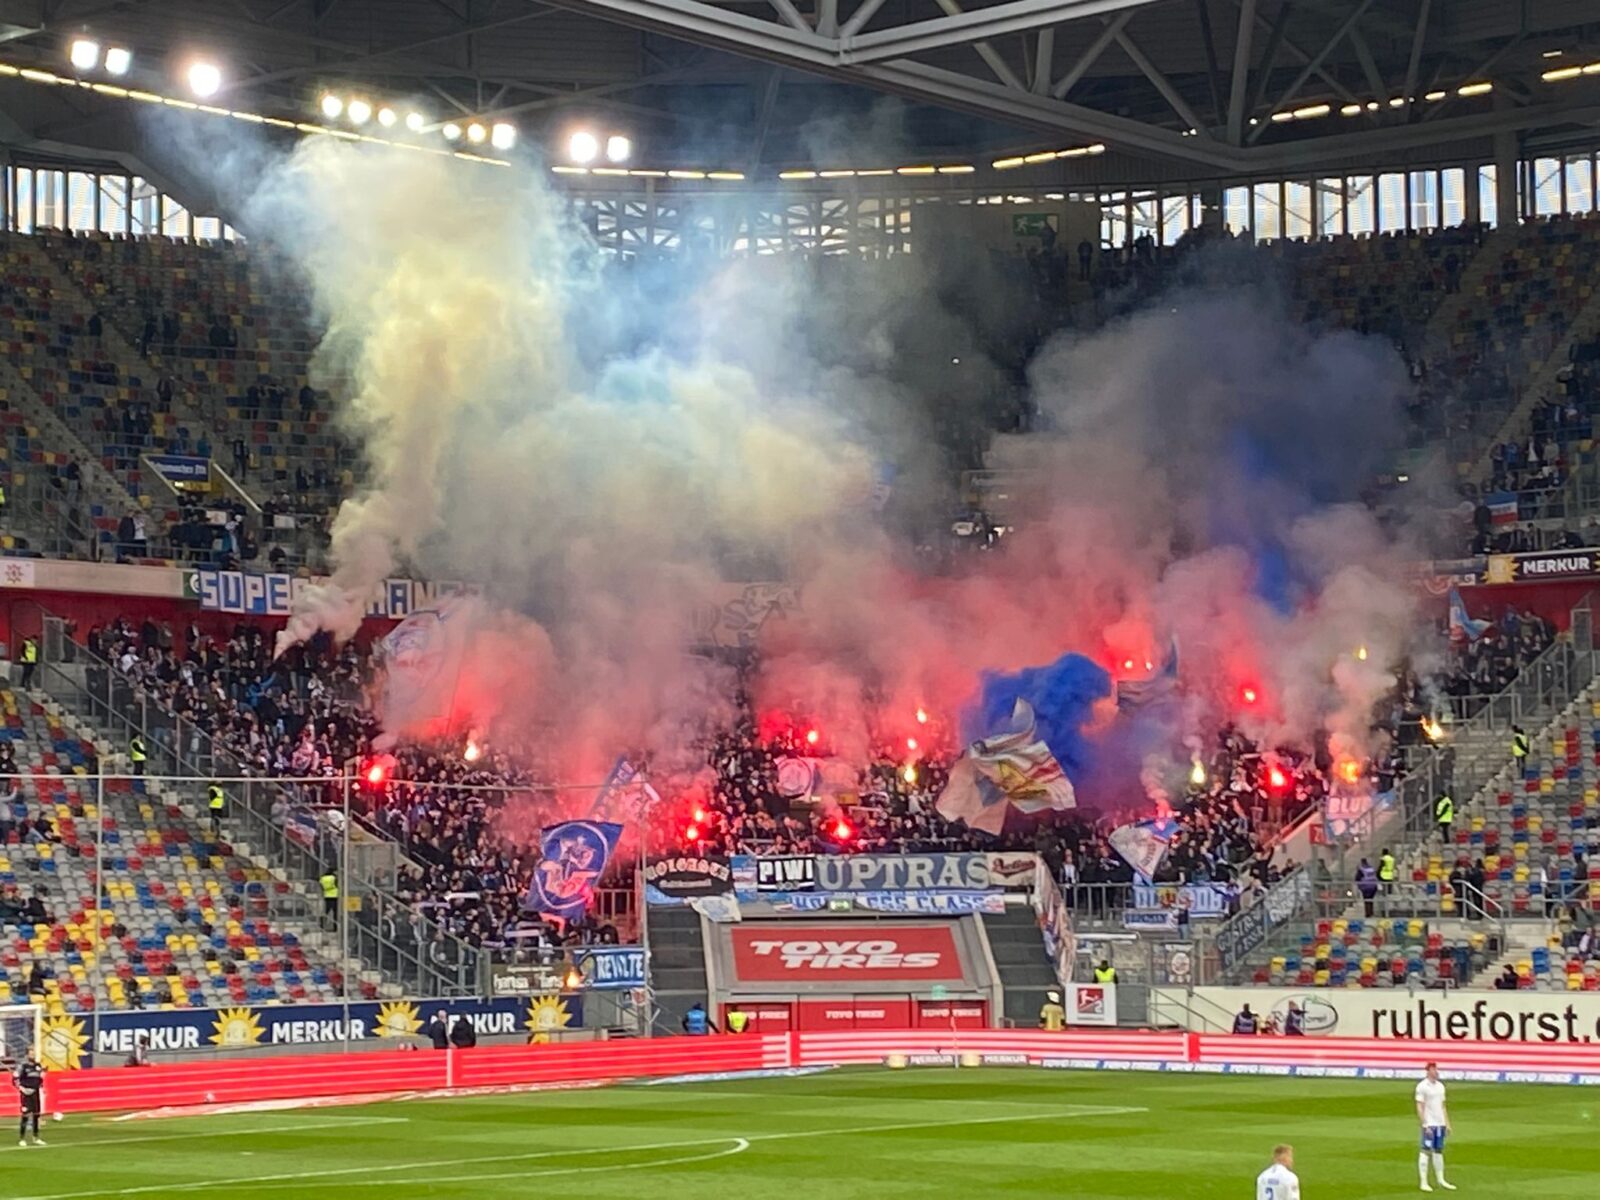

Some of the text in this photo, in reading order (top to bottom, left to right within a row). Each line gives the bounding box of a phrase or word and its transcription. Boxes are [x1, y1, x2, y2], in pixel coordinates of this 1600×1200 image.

[1523, 557, 1590, 574] MERKUR
[759, 859, 814, 882] PIWI
[750, 940, 897, 955] TOYO
[780, 953, 941, 968] TIRES
[825, 1010, 853, 1019] TOYO
[921, 1008, 949, 1018] TOYO
[1372, 1000, 1600, 1043] ruheforst.
[272, 1017, 365, 1044] MERKUR
